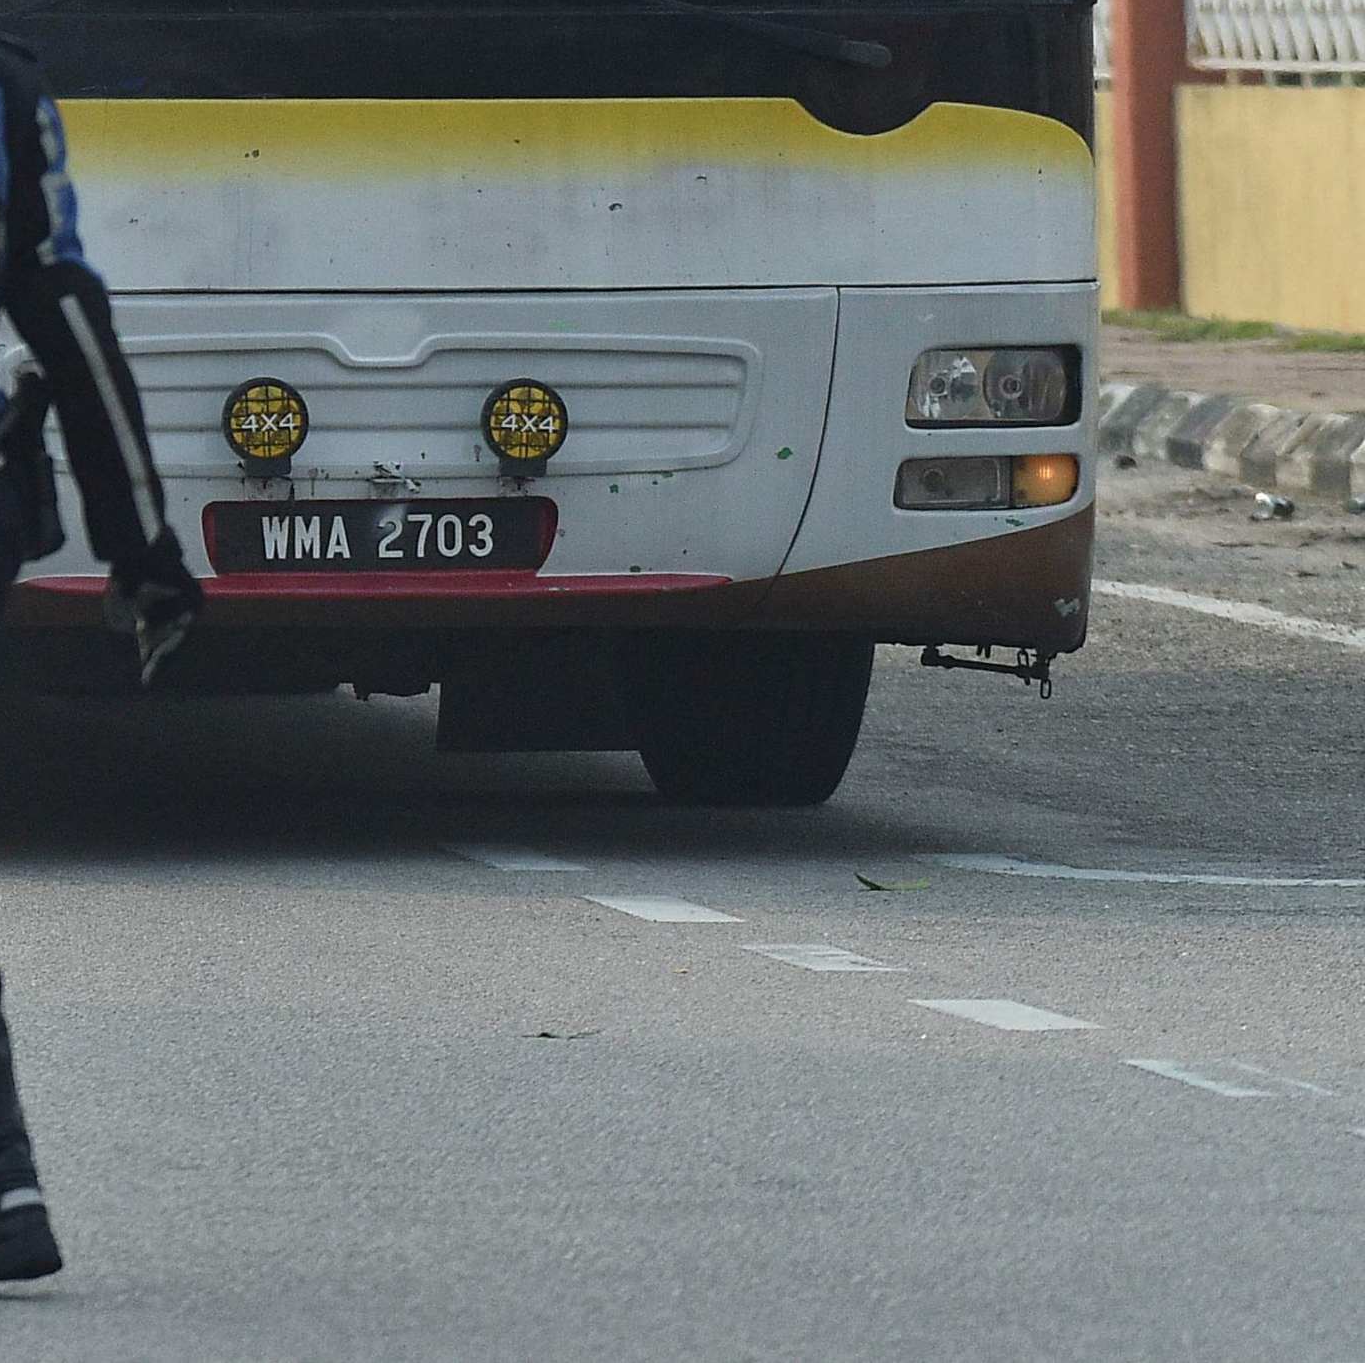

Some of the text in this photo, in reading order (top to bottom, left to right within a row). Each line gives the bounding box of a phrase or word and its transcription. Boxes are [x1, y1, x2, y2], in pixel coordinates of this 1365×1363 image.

[241, 412, 300, 433] 4X4
[500, 412, 557, 434] 4X4
[261, 513, 495, 560] WMA 2703
